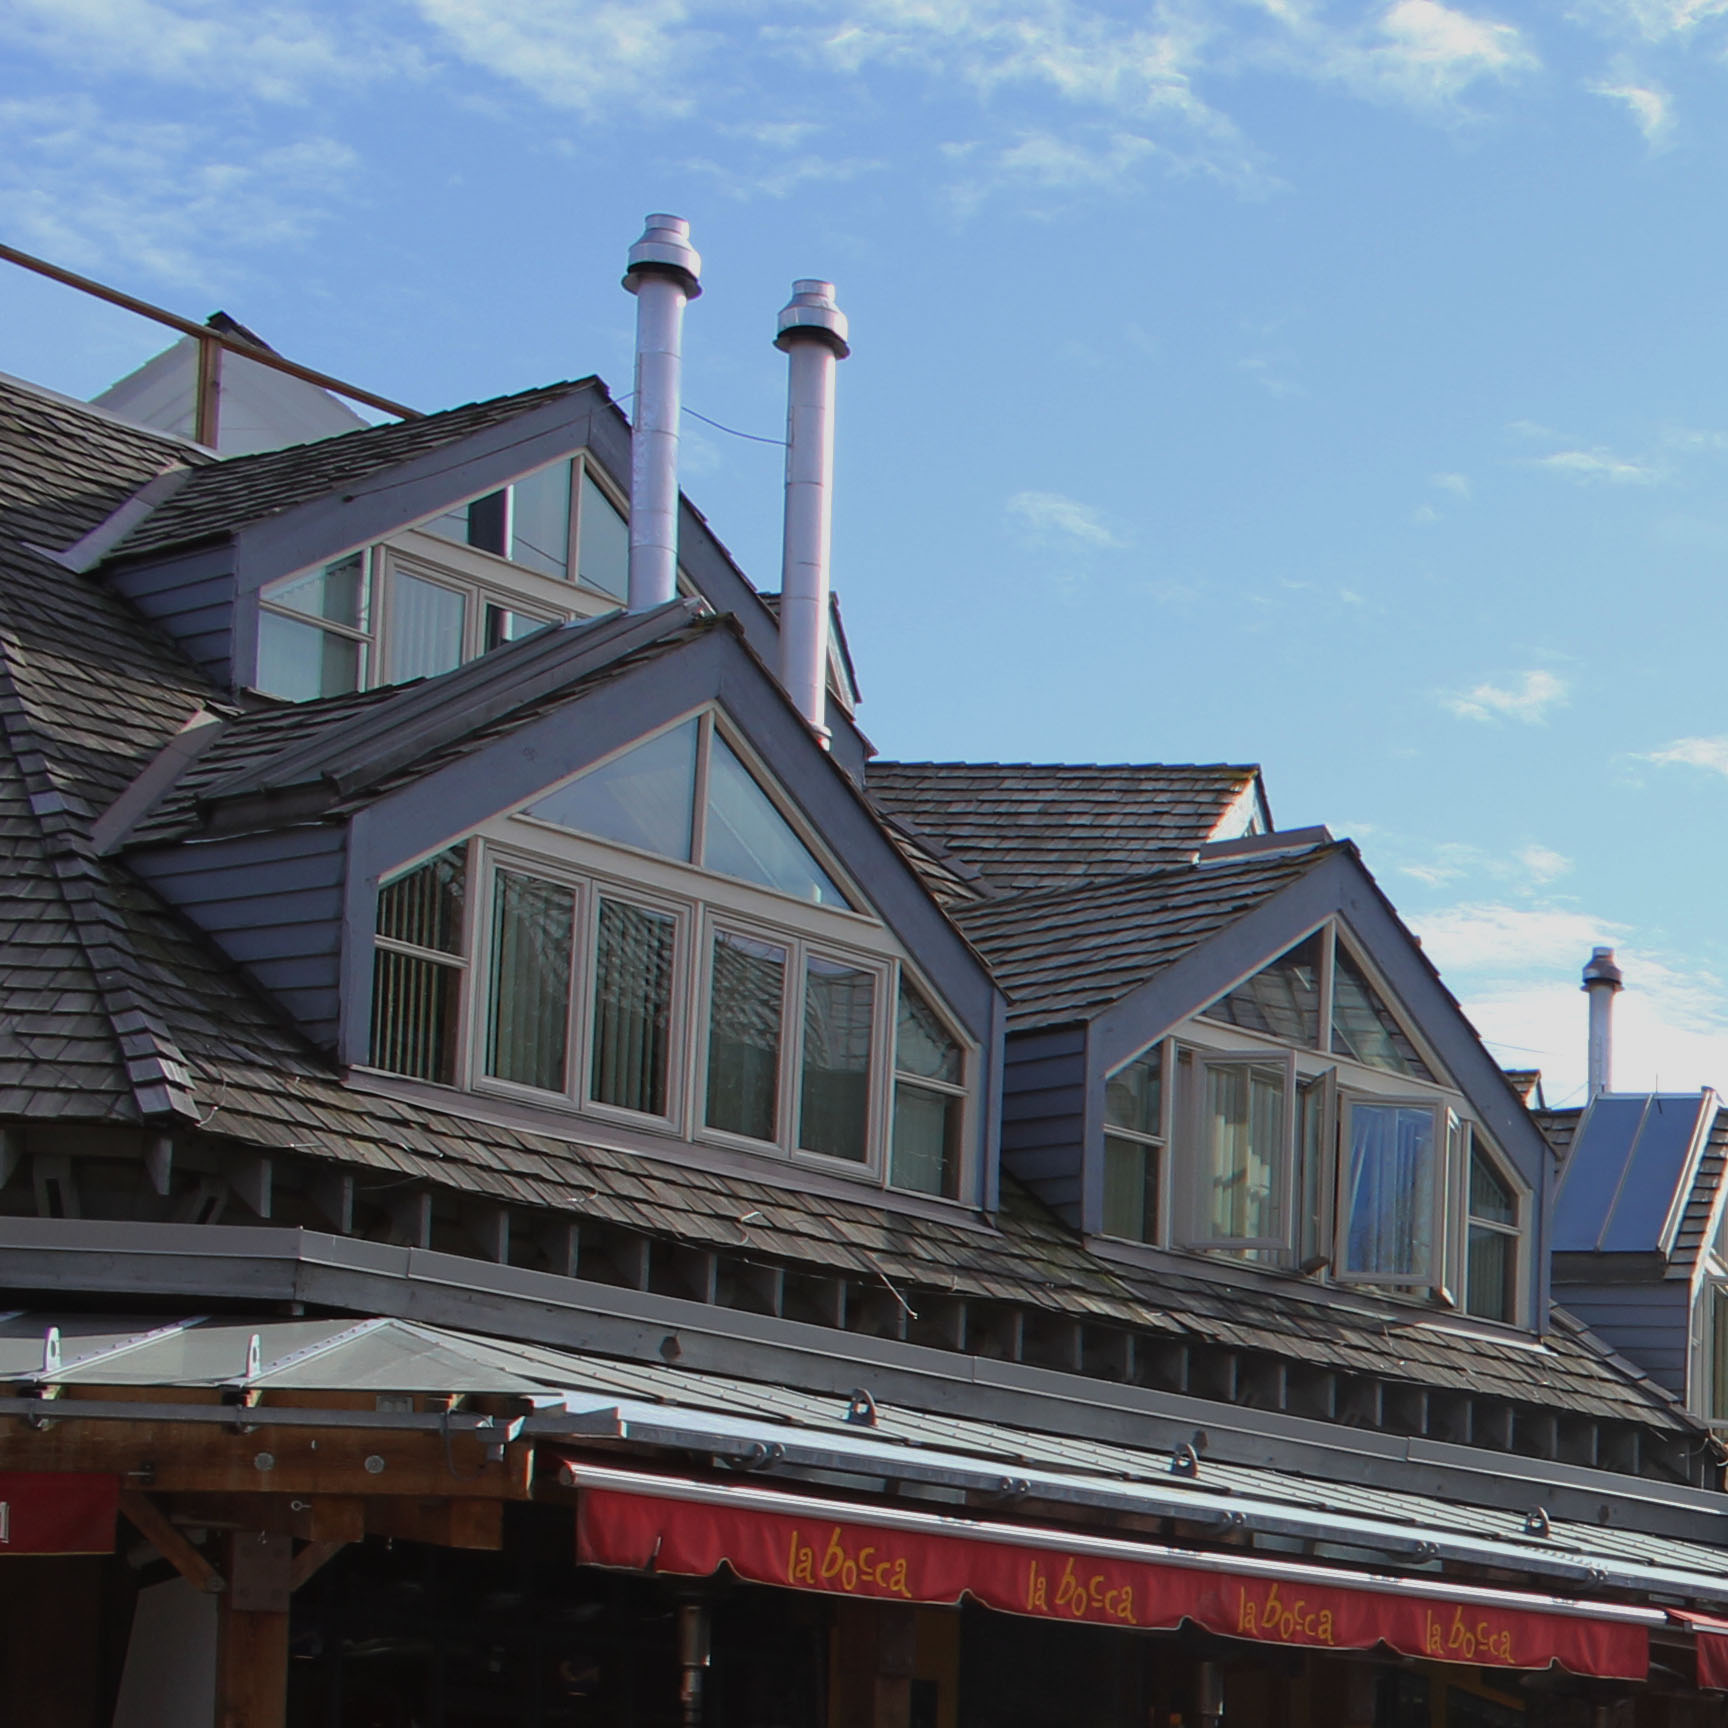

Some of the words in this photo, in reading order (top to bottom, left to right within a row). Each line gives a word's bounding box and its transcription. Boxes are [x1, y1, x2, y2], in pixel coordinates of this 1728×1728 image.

[788, 1530, 815, 1584] la
[821, 1526, 912, 1598] bocca
[1027, 1560, 1048, 1611] la
[1055, 1557, 1137, 1624] bocca
[1237, 1585, 1259, 1635] la
[1261, 1583, 1335, 1646] bocca
[1426, 1609, 1445, 1654] la
[1448, 1605, 1517, 1664] bocca
